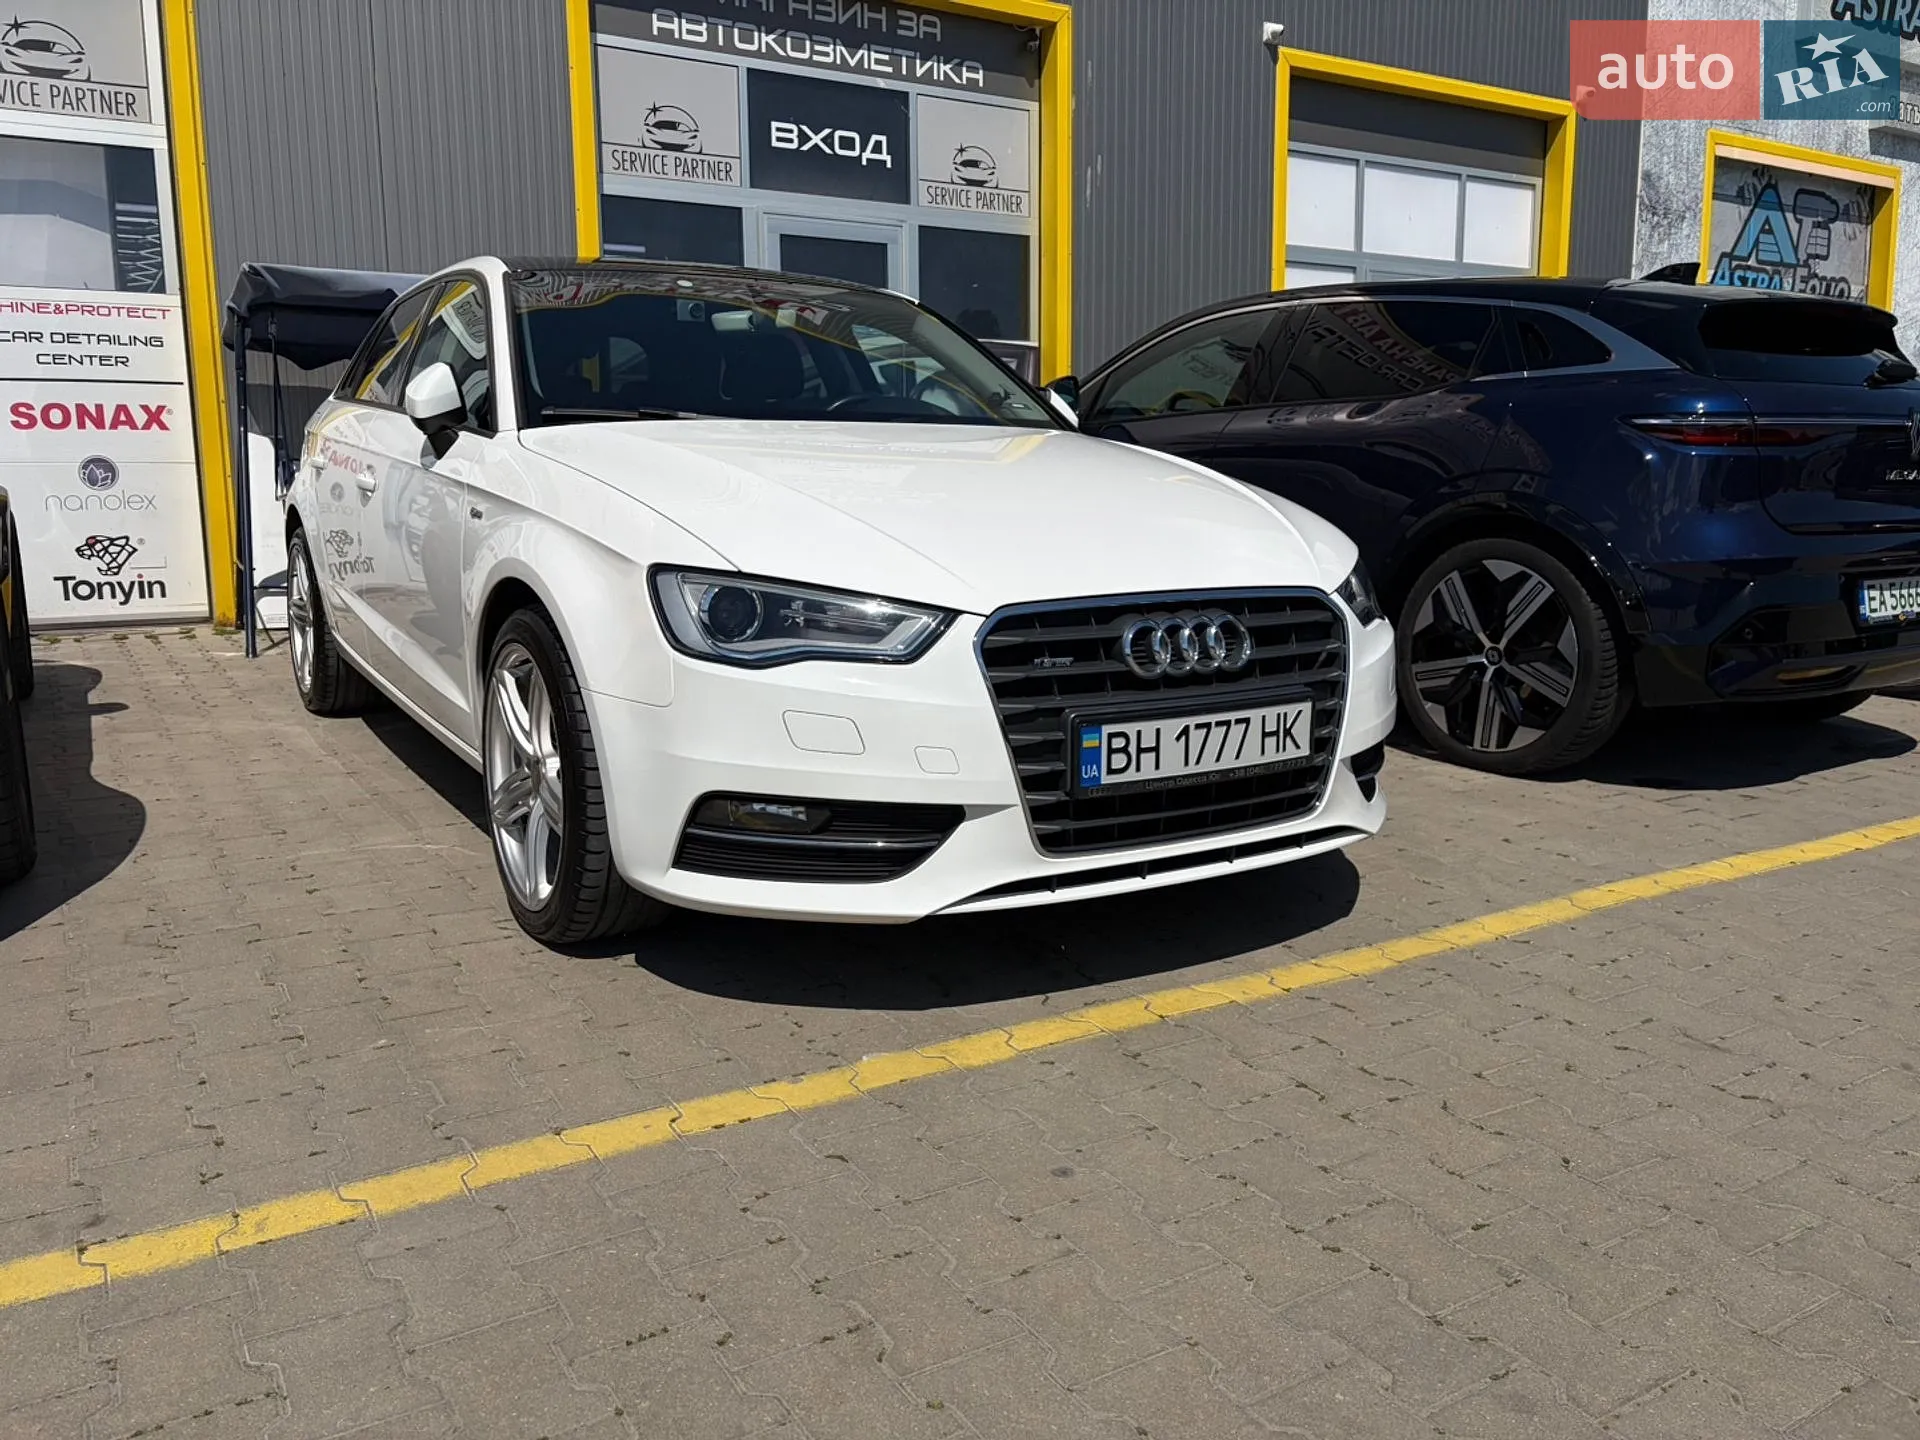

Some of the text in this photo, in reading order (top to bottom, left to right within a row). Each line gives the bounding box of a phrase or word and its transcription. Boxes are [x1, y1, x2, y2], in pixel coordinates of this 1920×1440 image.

[896, 9, 941, 42] ЗА
[651, 9, 984, 87] АВТОКОЗМЕТИКА
[0, 79, 138, 117] VICE PARTNER
[770, 120, 892, 168] ВХОД
[612, 149, 733, 182] SERVICE PARTNER
[926, 185, 1023, 214] SERVICE PARTNER
[0, 301, 171, 320] HINE&PROTECT
[50, 332, 164, 348] DETAILING
[36, 353, 130, 367] CENTER
[10, 402, 170, 431] SONAX
[45, 491, 157, 511] nanolex
[53, 574, 167, 605] Tonyin
[1106, 709, 1303, 775] BH 1777 HK
[1082, 764, 1099, 779] UA
